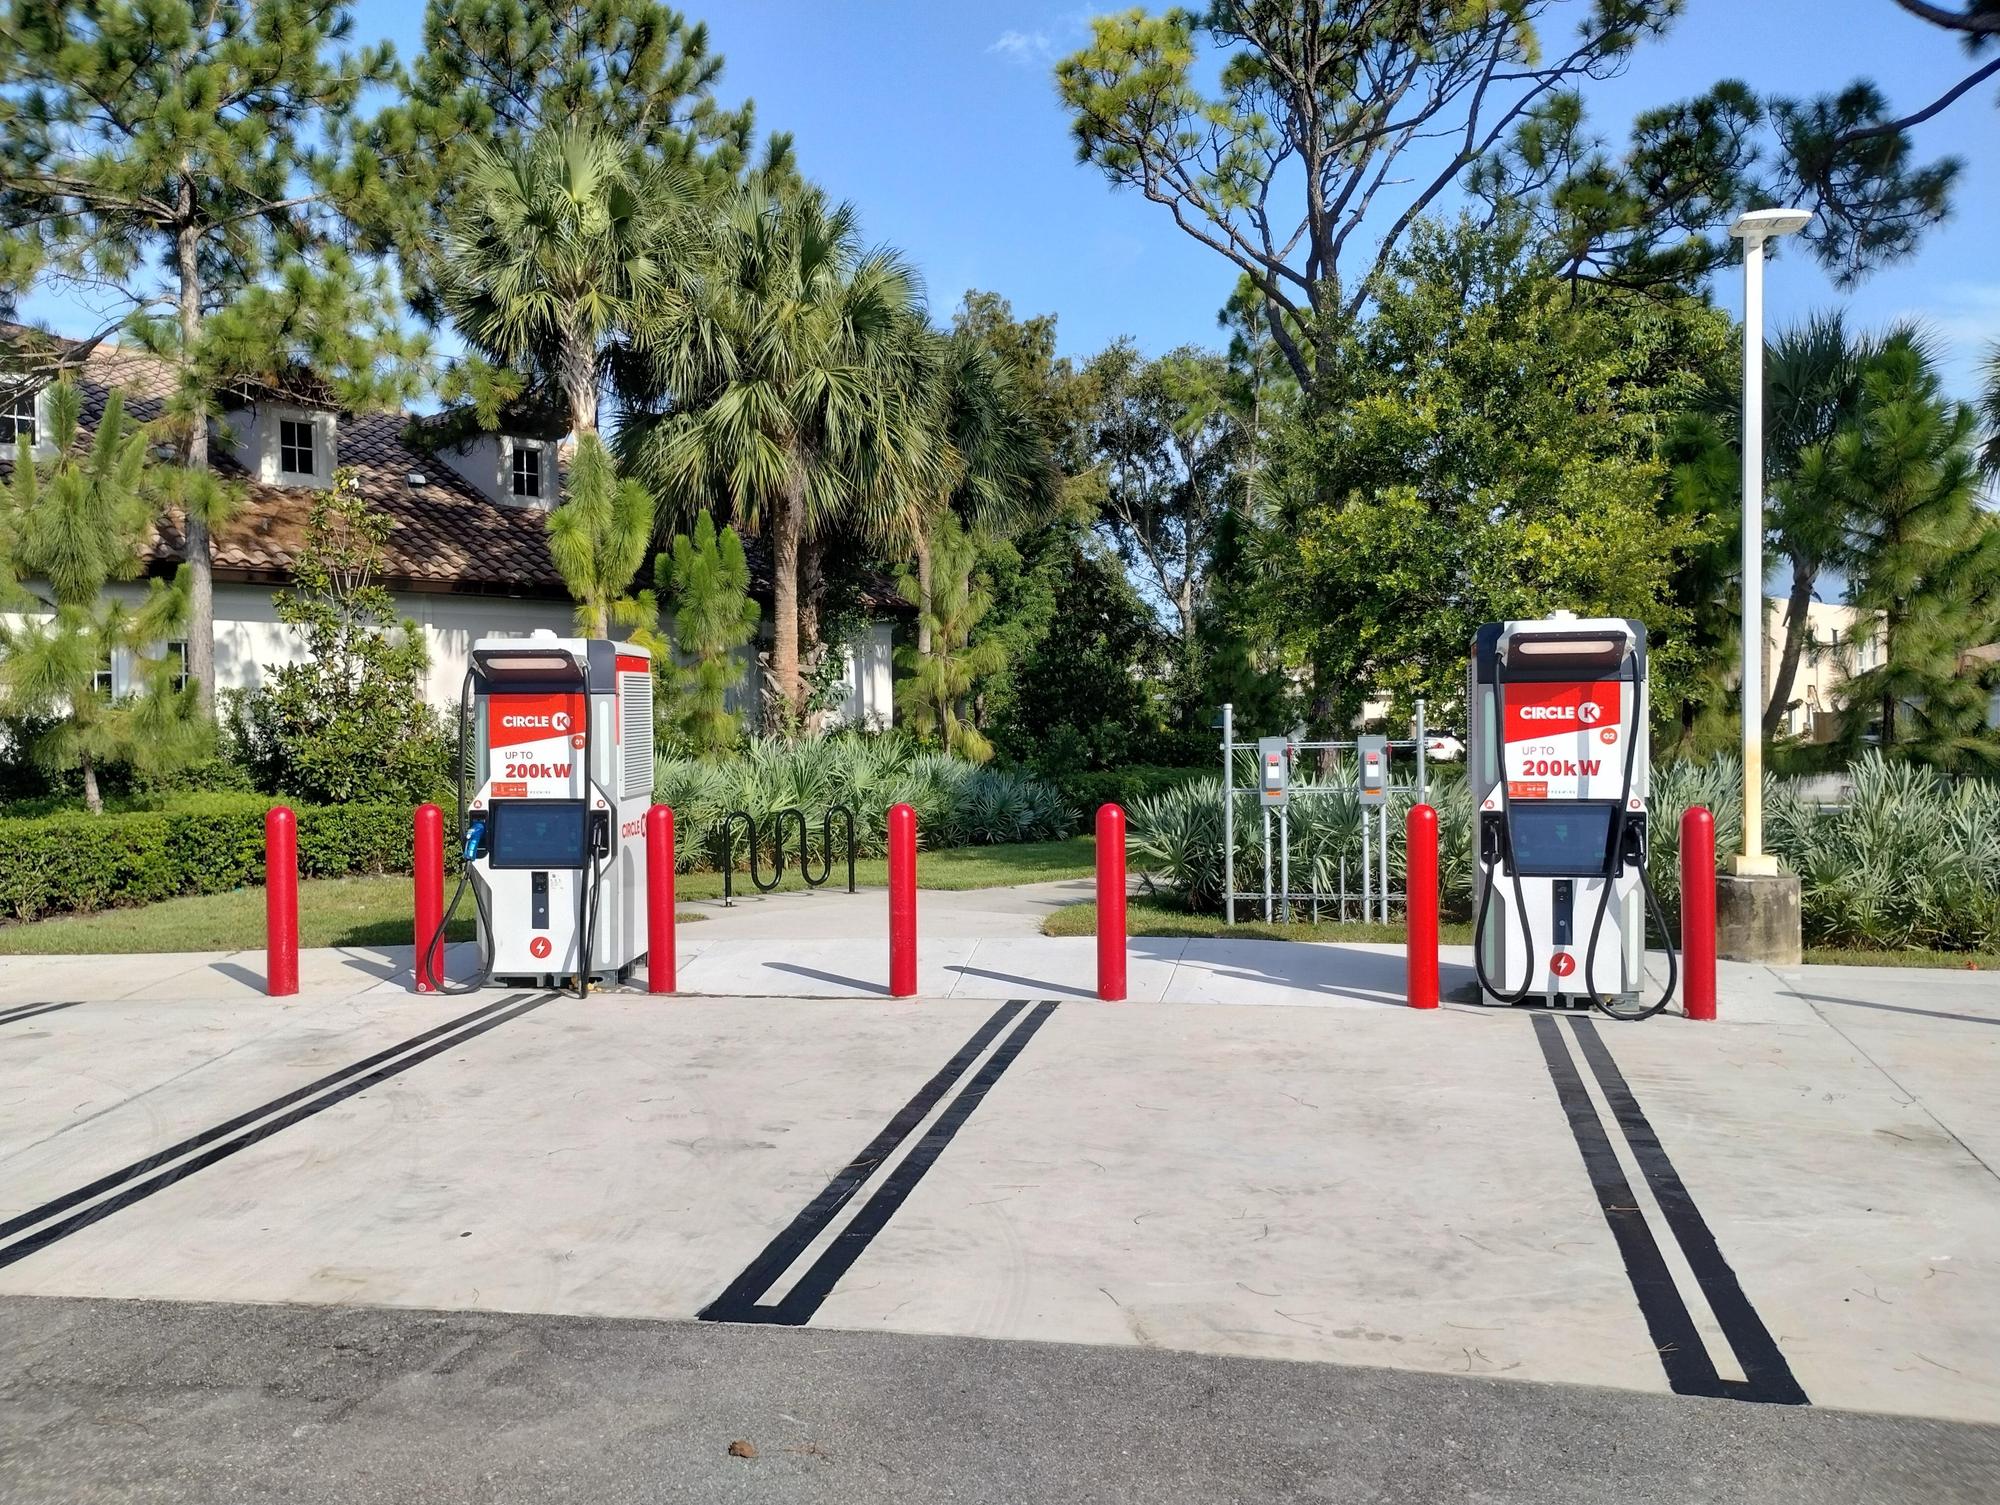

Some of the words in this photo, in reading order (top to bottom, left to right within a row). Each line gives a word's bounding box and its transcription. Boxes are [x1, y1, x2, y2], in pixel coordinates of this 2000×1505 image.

[1520, 706, 1575, 719] CIRCLE
[502, 716, 549, 727] CIRCLE
[505, 751, 518, 759] UP
[520, 751, 533, 759] TO
[1522, 746, 1537, 755] UP
[1540, 746, 1555, 755] TO
[505, 764, 572, 778] 200kW
[1523, 760, 1601, 776] 200kW
[622, 820, 640, 838] CIRCLE
